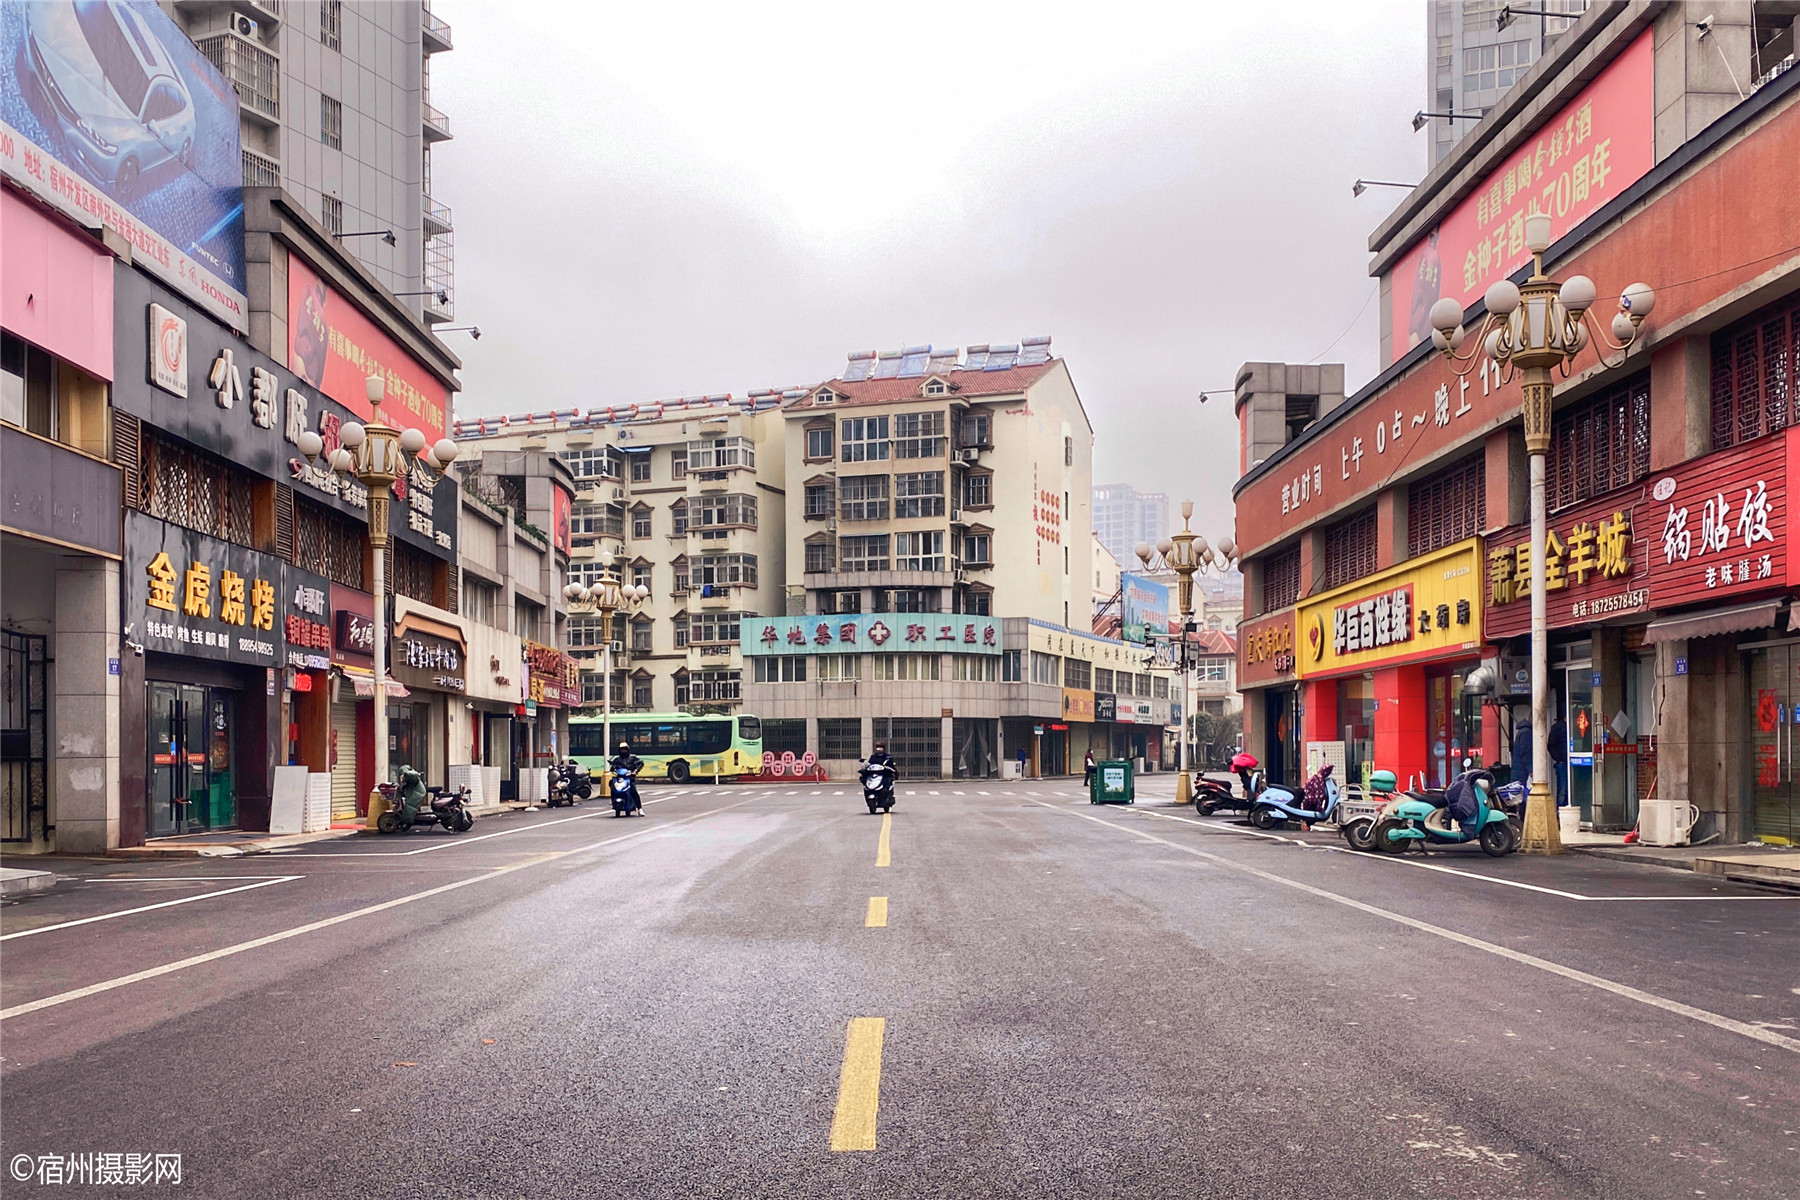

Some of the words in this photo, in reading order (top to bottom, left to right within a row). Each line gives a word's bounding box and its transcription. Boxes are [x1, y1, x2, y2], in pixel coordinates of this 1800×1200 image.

[200, 279, 241, 316] HONDA
[1342, 436, 1364, 481] 上午
[1661, 480, 1775, 565] 锅贴饺
[1489, 511, 1630, 607] 萧县全羊城
[146, 552, 275, 631] 金虎烧烤
[760, 622, 857, 648] 华地集团
[905, 623, 997, 647] 职工医院
[1417, 598, 1470, 634] 大药房
